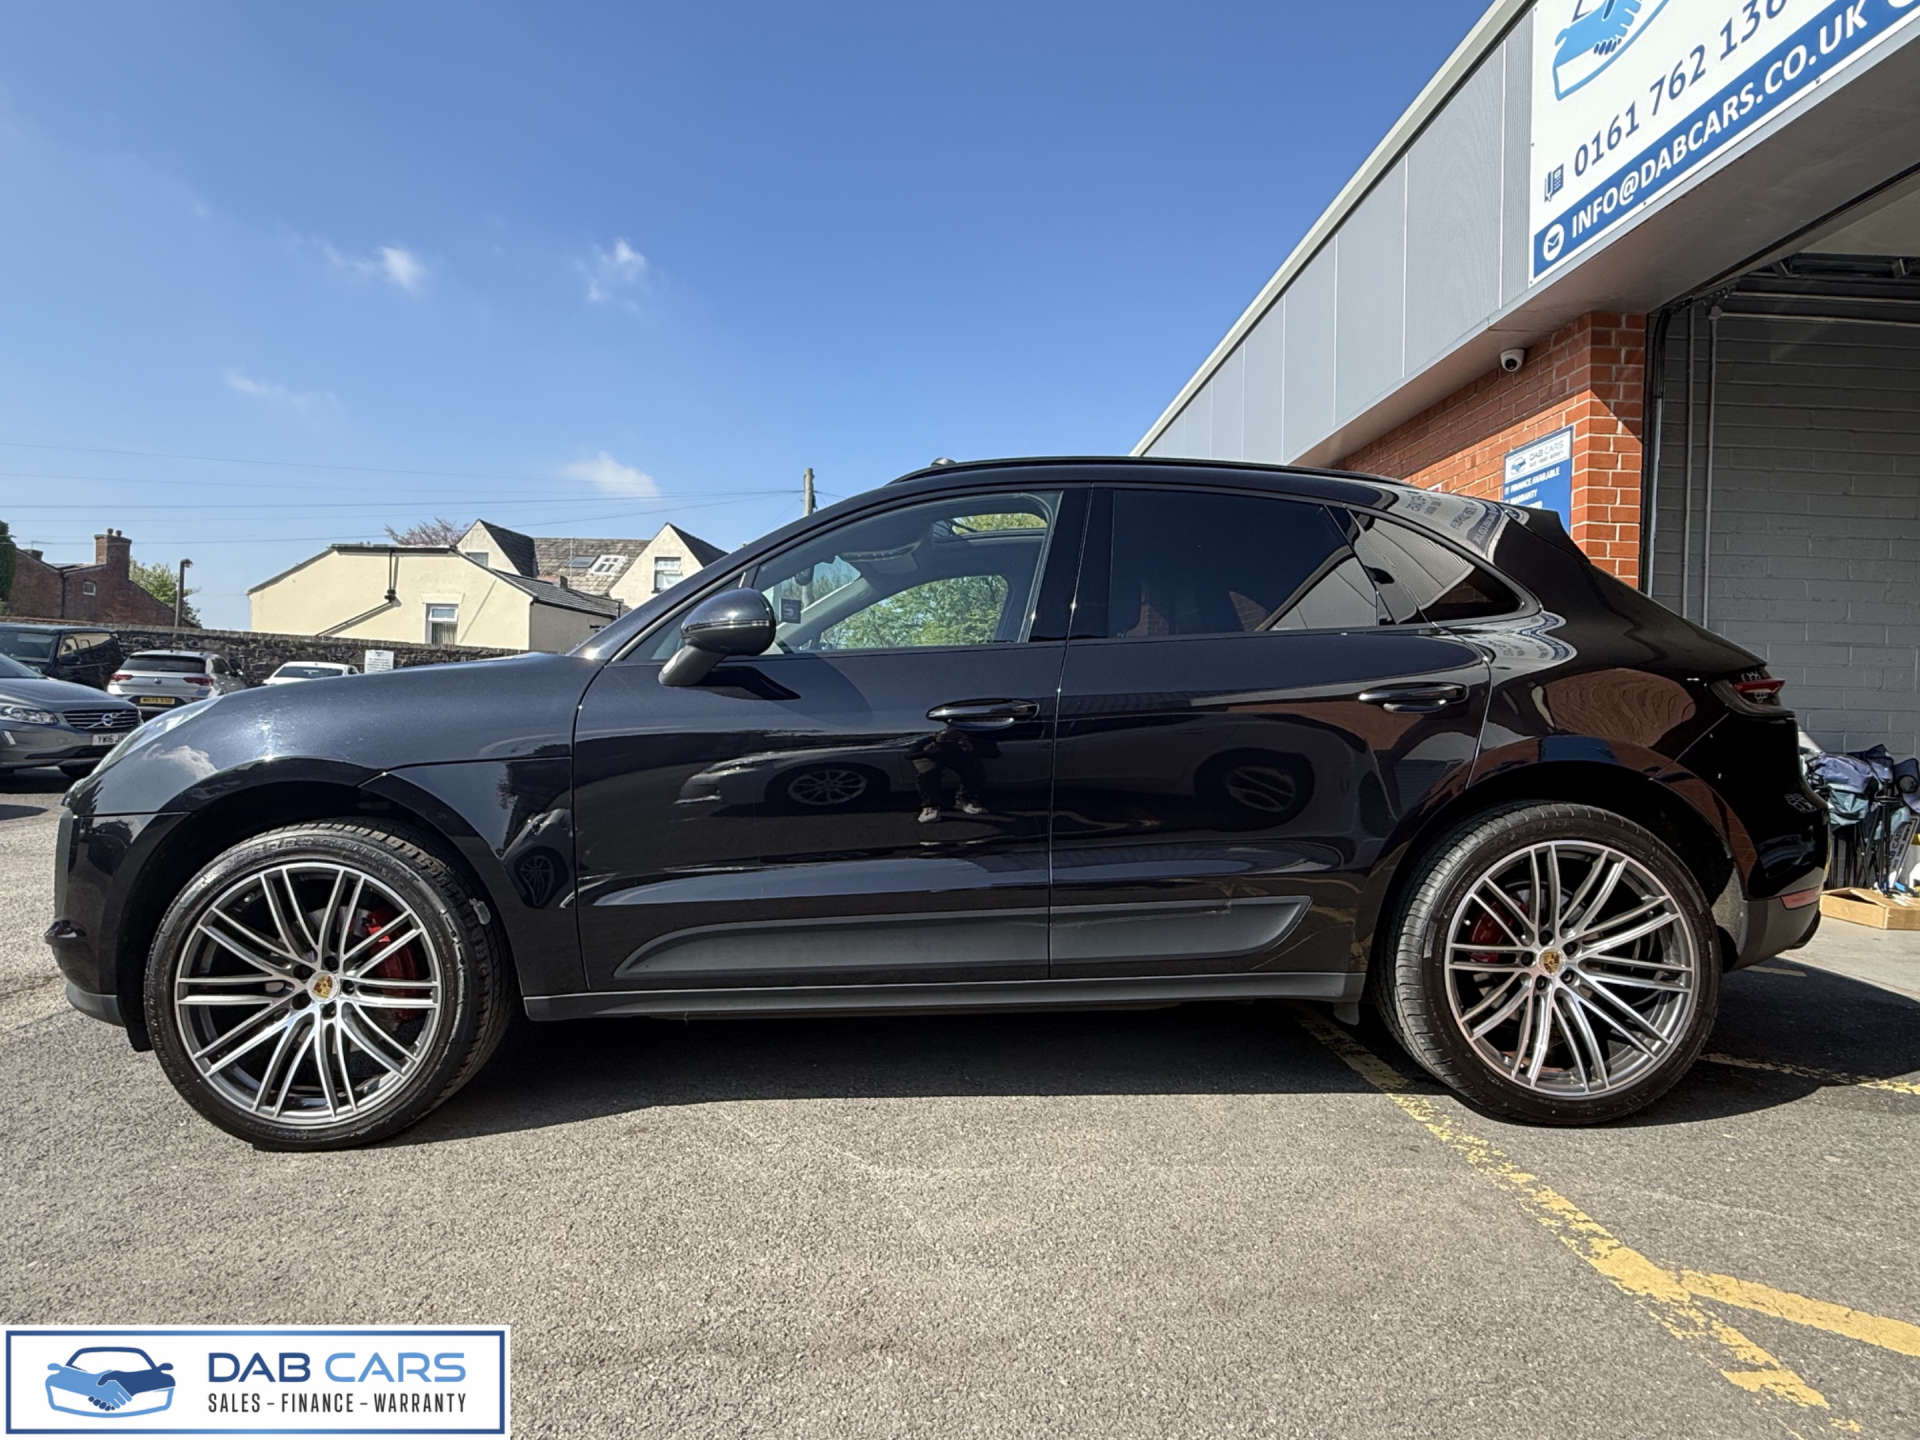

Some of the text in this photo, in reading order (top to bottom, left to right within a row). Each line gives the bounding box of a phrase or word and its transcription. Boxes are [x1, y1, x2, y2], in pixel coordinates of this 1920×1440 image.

[1572, 0, 1868, 238] INFO@DABCARS.CO.UK
[1575, 100, 1640, 177] 0161
[1650, 44, 1706, 116] 762
